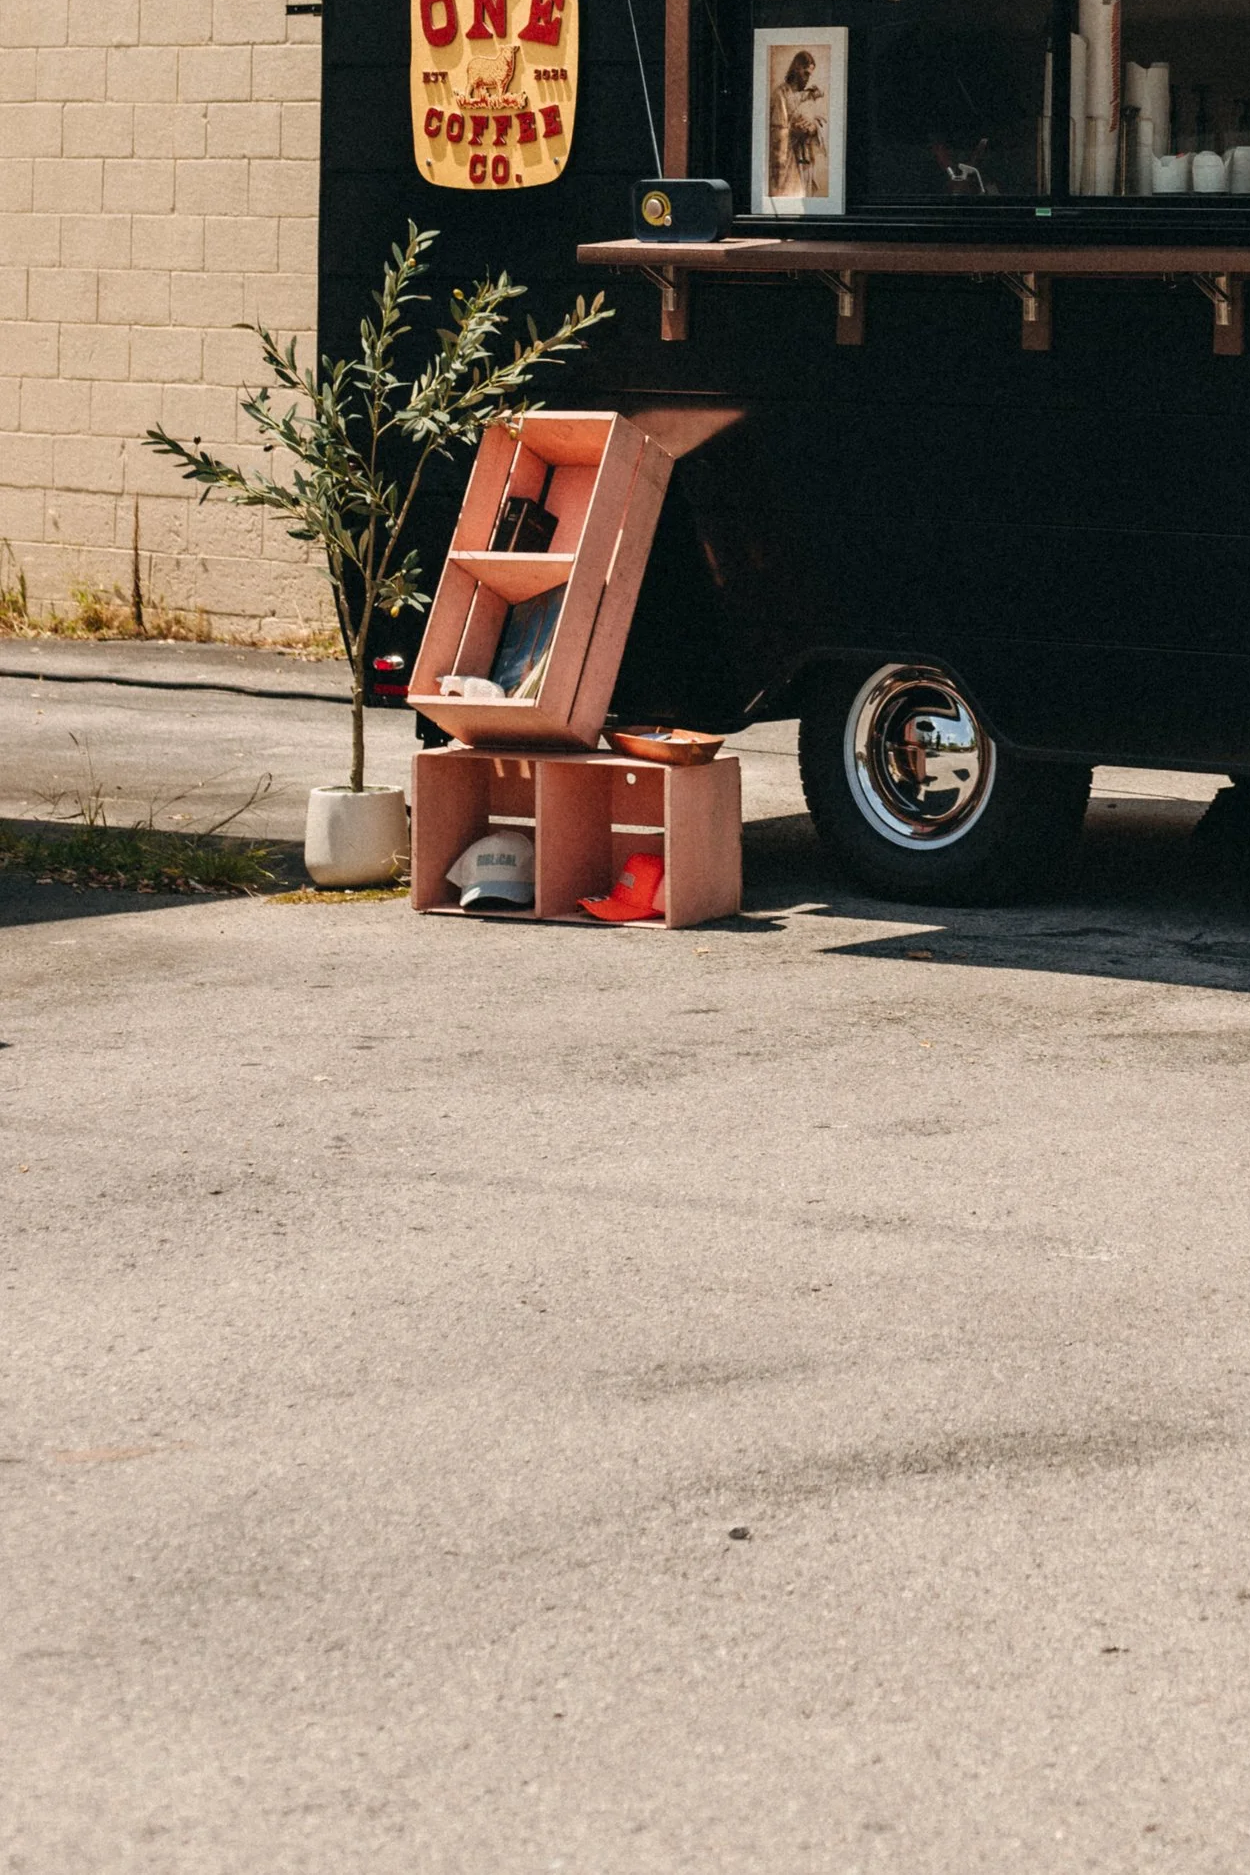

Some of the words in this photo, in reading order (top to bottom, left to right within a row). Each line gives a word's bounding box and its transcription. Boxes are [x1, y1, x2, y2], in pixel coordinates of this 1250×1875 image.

[422, 71, 449, 85] EST
[424, 104, 564, 146] COFFEE
[469, 154, 523, 186] CO.
